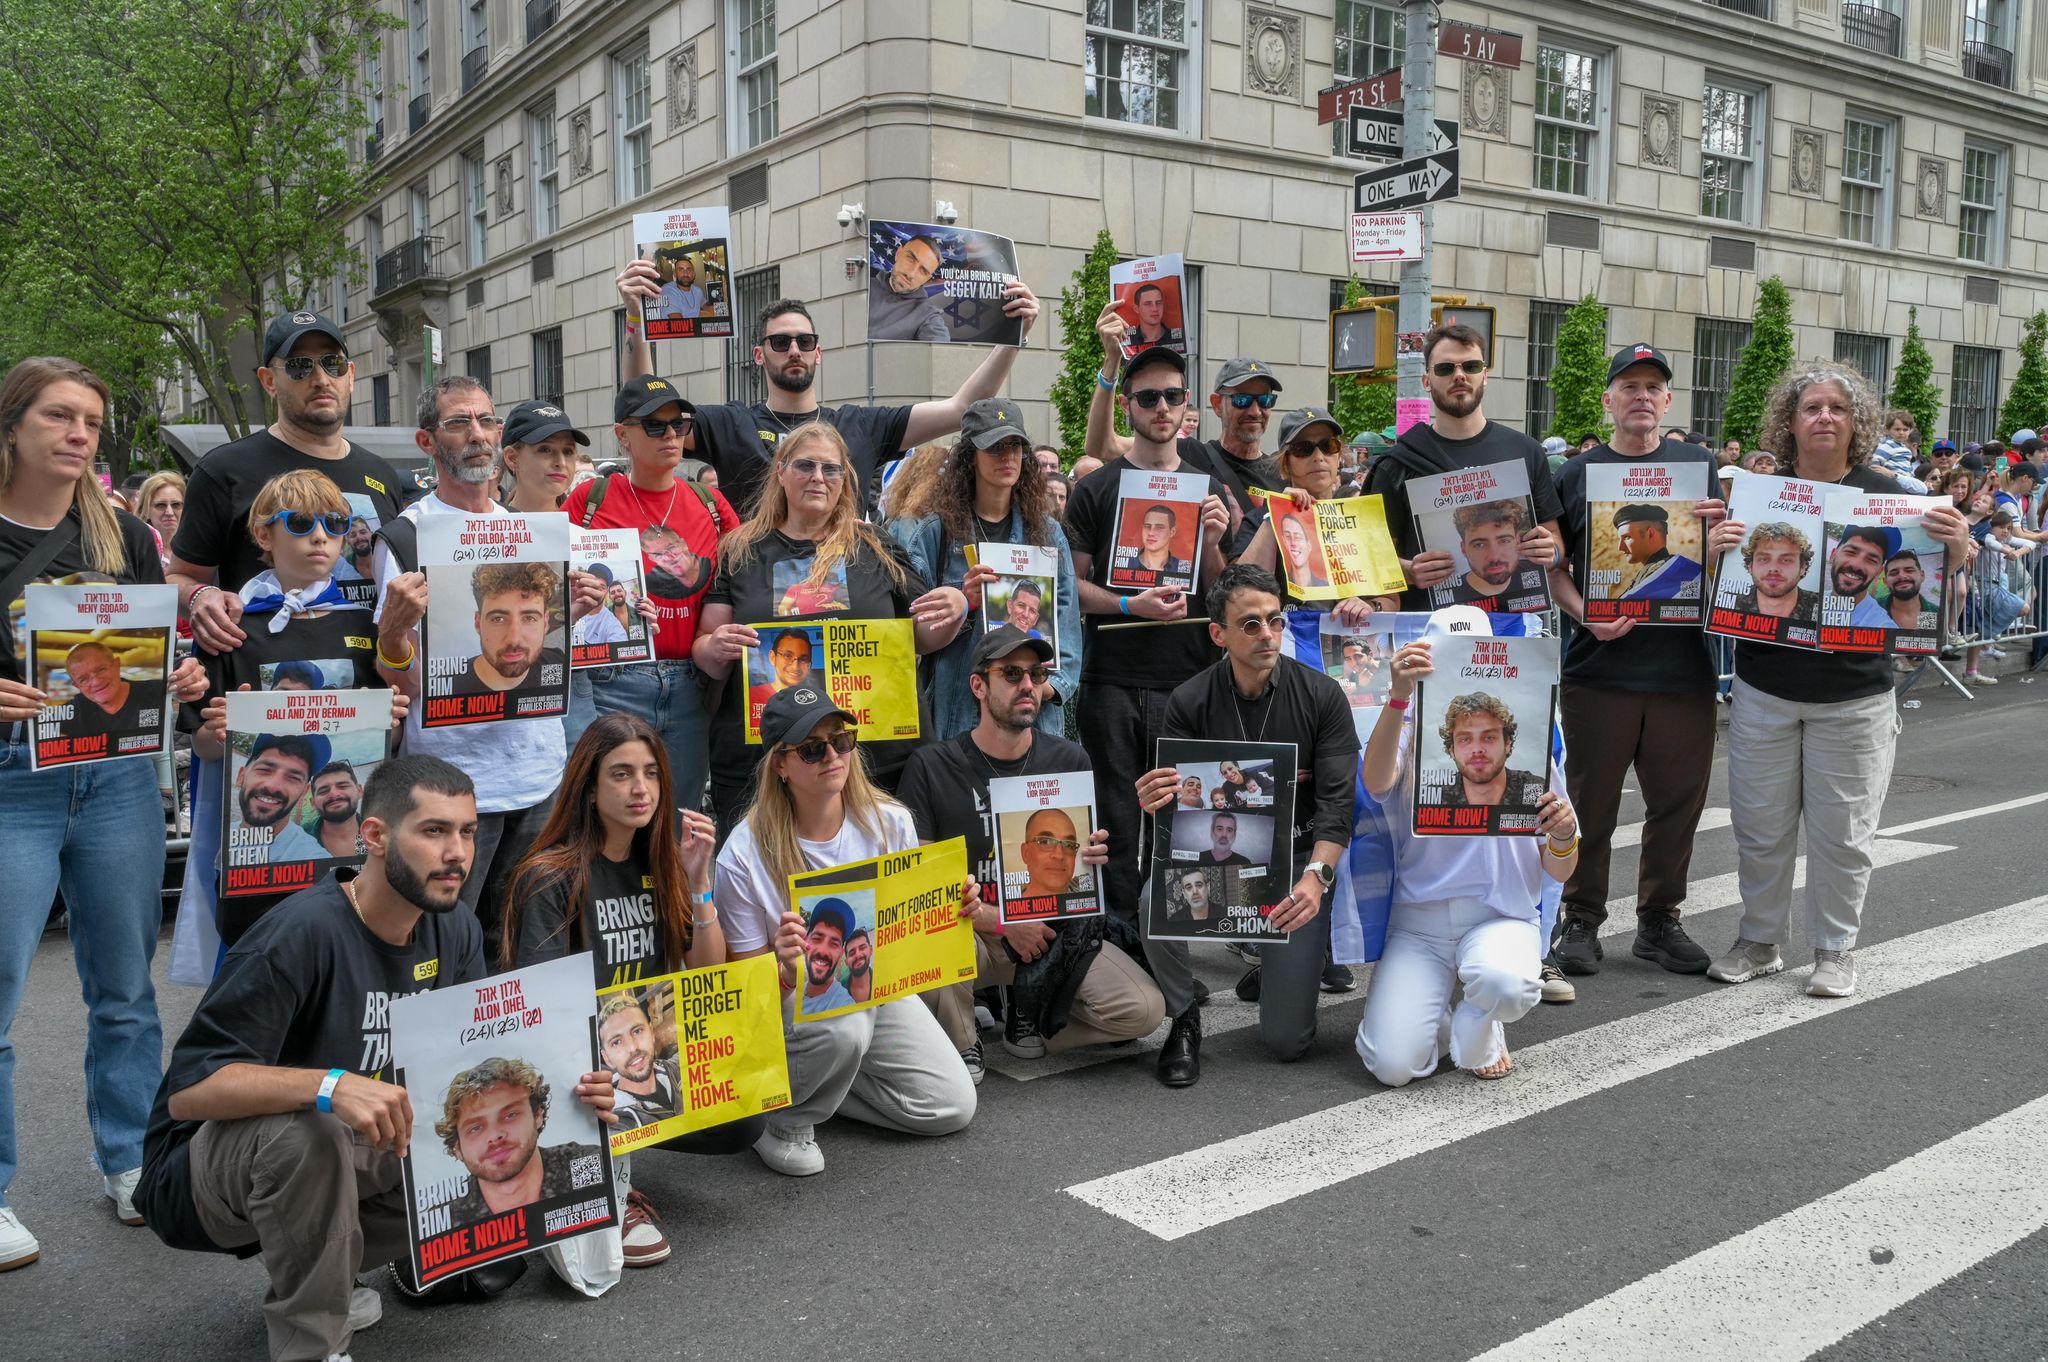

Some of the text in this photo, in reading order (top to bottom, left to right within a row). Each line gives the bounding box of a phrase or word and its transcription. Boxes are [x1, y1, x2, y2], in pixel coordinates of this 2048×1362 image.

[1462, 33, 1496, 61] 5 Av
[1336, 94, 1343, 116] E
[1349, 88, 1364, 106] 73
[1370, 80, 1386, 106] St
[1366, 123, 1397, 144] ONE
[1367, 167, 1441, 203] ONE WAY
[1355, 216, 1406, 227] NO PARKING
[1355, 227, 1406, 239] Monday Friday
[1355, 237, 1390, 247] 7am 4pm
[940, 267, 954, 279] YOU
[955, 269, 969, 281] CAN
[970, 271, 990, 282] BRING
[991, 272, 1001, 282] ME
[944, 280, 1018, 300] SEGEV KALF
[646, 307, 660, 320] HIM
[647, 321, 669, 334] HOME
[671, 319, 694, 333] NOW!
[1440, 478, 1498, 497] GUY GILBOA-DALAL
[1622, 477, 1672, 487] MATAN ANGREST
[1784, 481, 1814, 494] אלון אהל
[1779, 492, 1814, 504] ALON OHEL
[1316, 502, 1345, 516] DON'T
[1853, 507, 1923, 516] GALI AND ZIV BERMAN
[513, 519, 526, 531] גיא
[1320, 515, 1357, 530] FORGET
[1880, 516, 1894, 525] (26)
[460, 532, 533, 545] GUY GILBOA-DALAL
[1322, 531, 1338, 544] ME
[1116, 545, 1138, 558] BRING
[1325, 543, 1358, 558] BRING
[1114, 557, 1129, 568] HIM
[1328, 558, 1346, 571] ME
[1113, 568, 1134, 580] HOME
[1134, 570, 1157, 582] NOW!
[1331, 570, 1367, 586] HOME.
[1589, 569, 1621, 584] BRING
[1588, 584, 1609, 600] HIM
[1718, 578, 1751, 596] BRING
[84, 593, 122, 602] מני גודארד
[1434, 588, 1455, 605] HIM
[1716, 593, 1737, 610] HIM
[1822, 595, 1855, 611] BRING
[78, 604, 129, 613] MENY GODARD
[1588, 600, 1650, 616] HOME NOW!
[96, 614, 111, 625] (73)
[1449, 621, 1472, 633] NOW.
[1712, 609, 1744, 626] HOME
[1746, 615, 1779, 633] NOW!
[1821, 611, 1851, 627] THEM
[829, 624, 868, 641] DON'T
[1820, 628, 1851, 644] HOME
[1853, 628, 1885, 645] NOW!
[587, 643, 610, 660] NOW!
[830, 641, 880, 658] FORGET
[1475, 641, 1507, 653] אלון אהל
[428, 656, 468, 677] BRING
[831, 659, 851, 675] ME
[1471, 654, 1509, 665] ALON OHEL
[427, 677, 453, 697] HIM
[832, 675, 872, 692] BRING
[287, 695, 337, 708] גלי וזיו ברמן
[427, 692, 505, 719] HOME NOW!
[832, 692, 852, 709] ME
[38, 705, 74, 723] BRING
[266, 707, 356, 720] GALI AND ZIV BERMAN
[38, 722, 60, 740] HIM
[39, 733, 108, 759] HOME NOW!
[1420, 768, 1457, 787] BRING
[1027, 787, 1060, 798] LIOR RUDAEFF
[1419, 786, 1442, 805] HIM
[1417, 805, 1488, 826] HOME NOW!
[229, 826, 274, 847] BRING
[228, 847, 269, 867] THEM
[227, 861, 315, 888] HOME NOW!
[1004, 871, 1030, 885] BRING
[1005, 885, 1022, 899] HIM
[595, 893, 655, 931] BRING
[877, 901, 906, 928] DON'T
[908, 888, 943, 919] FORGET
[945, 883, 962, 905] ME
[1006, 900, 1031, 915] HOME
[1033, 896, 1059, 913] NOW!
[1227, 905, 1258, 917] BRING
[877, 904, 957, 948] BRING US HOME.
[602, 925, 655, 965] THEM
[418, 961, 438, 977] 590
[475, 979, 521, 1004] אלון אהל
[681, 969, 728, 998] DON'T
[873, 985, 891, 999] GALI
[891, 984, 898, 995] &
[898, 978, 909, 991] ZIV
[910, 967, 942, 987] BERMAN
[474, 995, 528, 1023] ALON OHEL
[682, 989, 743, 1020] FORGET
[684, 1018, 709, 1043] ME
[686, 1035, 735, 1066] BRING
[688, 1062, 712, 1088] ME
[690, 1079, 740, 1111] HOME.
[625, 1123, 660, 1144] BOCHBOT
[417, 1174, 471, 1214] BRING
[544, 1196, 608, 1221] HOSTAGES AND MISSING
[418, 1203, 452, 1241] HIM
[545, 1205, 610, 1234] FAMILIES FORUM
[420, 1207, 527, 1271] HOME NOW!
